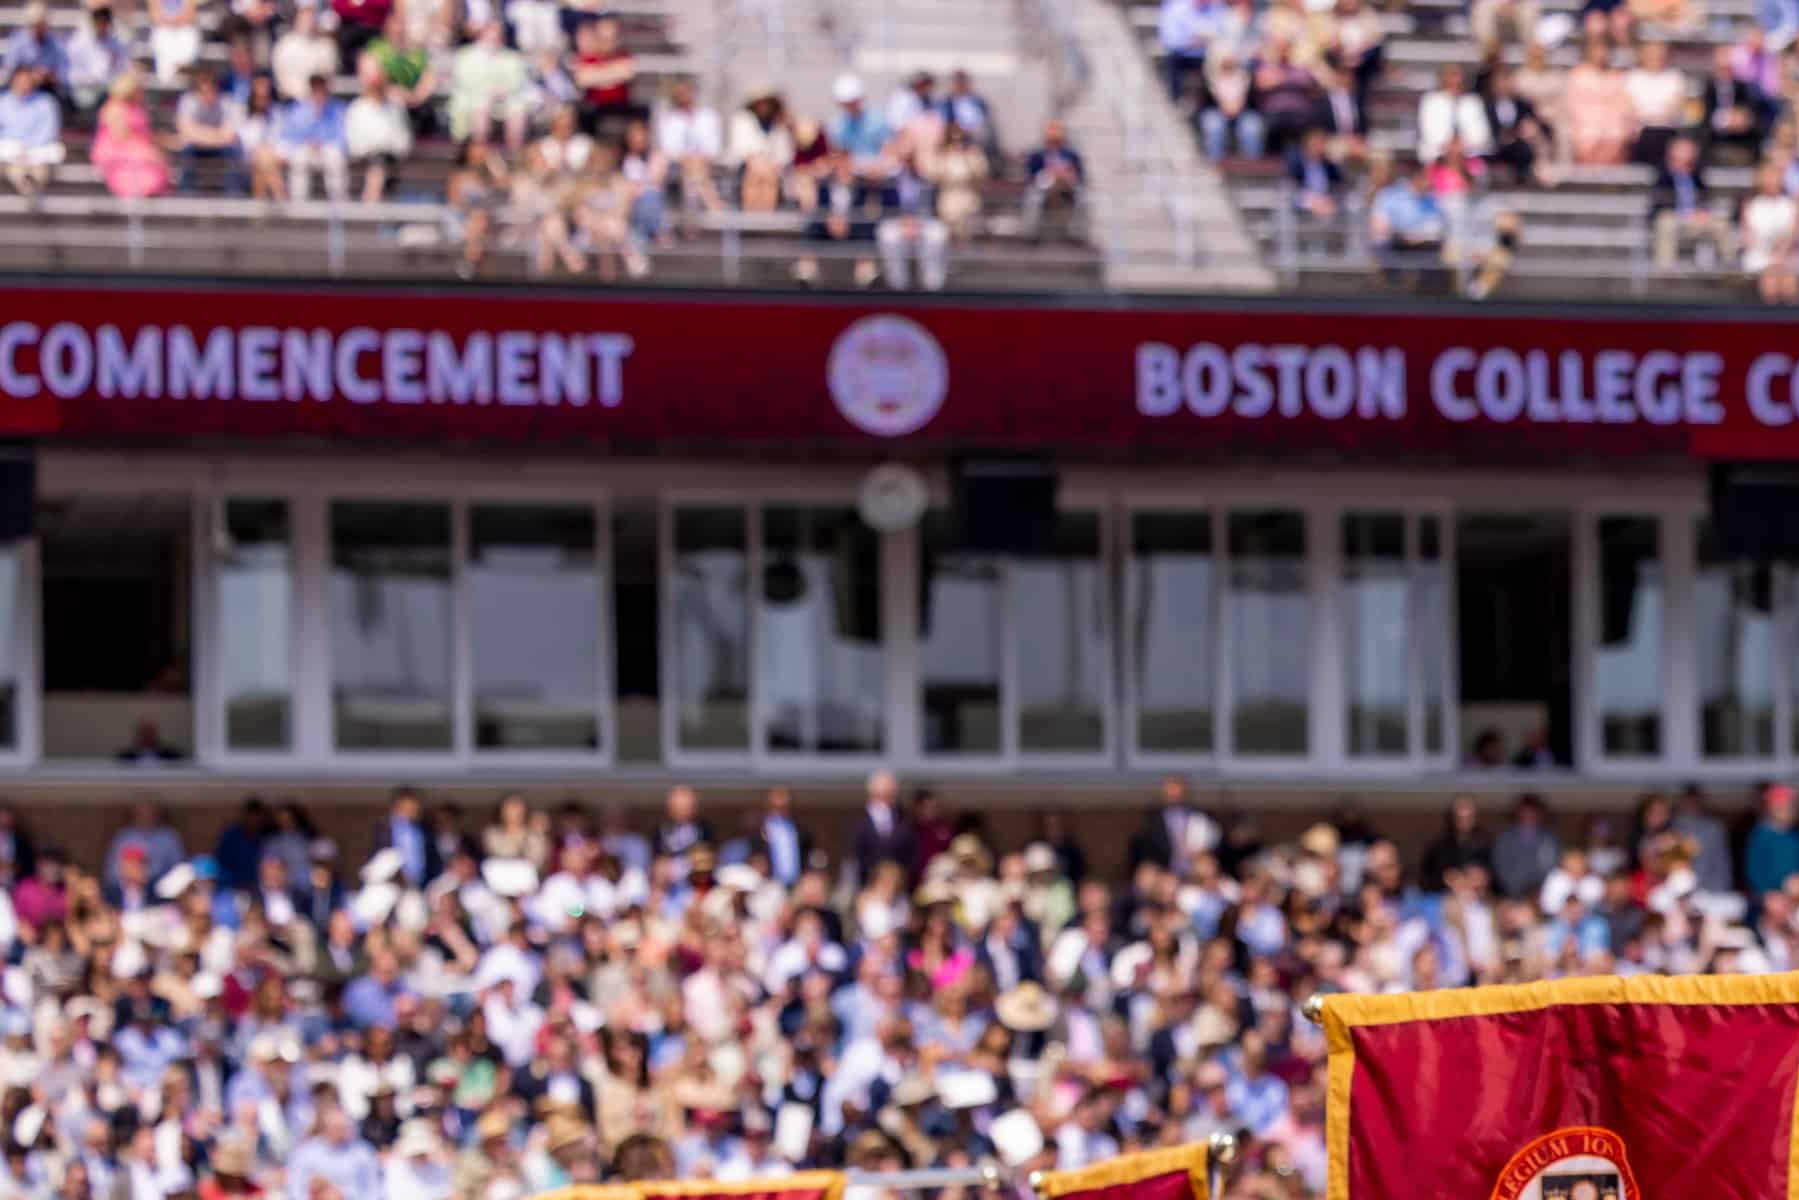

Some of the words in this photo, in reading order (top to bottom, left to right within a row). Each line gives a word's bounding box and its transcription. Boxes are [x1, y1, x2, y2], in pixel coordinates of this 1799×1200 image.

[0, 320, 634, 407] COMMENCEMENT
[1134, 341, 1406, 419] BOSTON
[1430, 347, 1726, 424] COLLEGE
